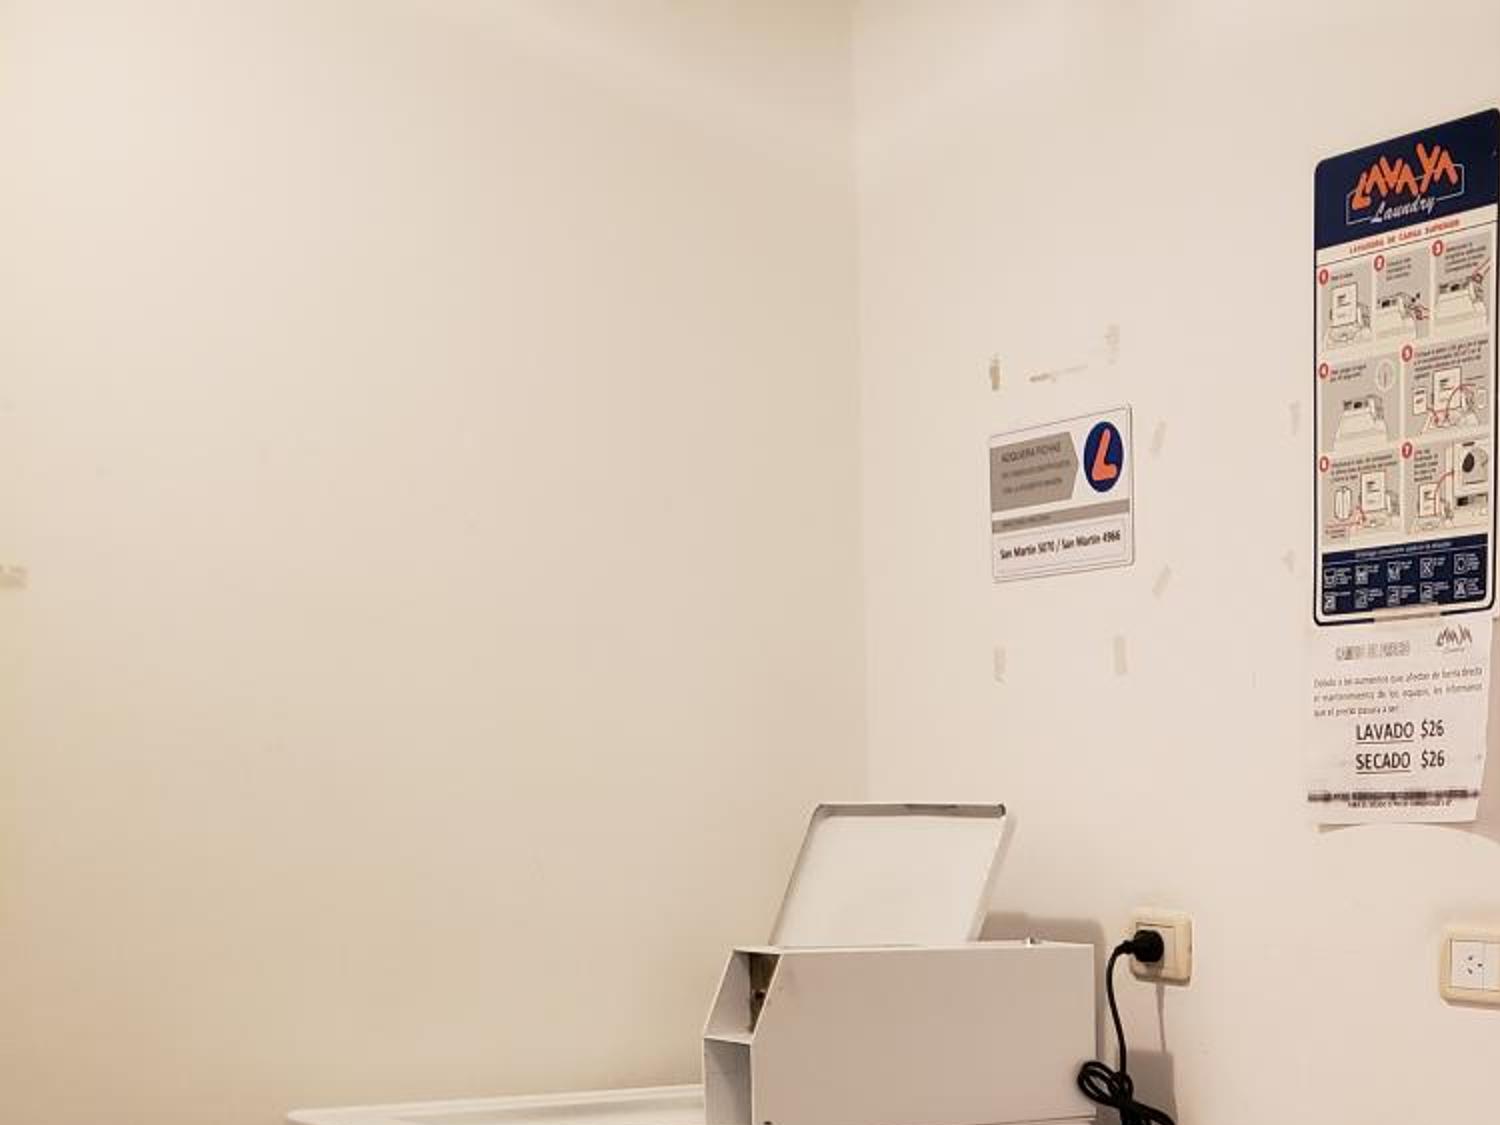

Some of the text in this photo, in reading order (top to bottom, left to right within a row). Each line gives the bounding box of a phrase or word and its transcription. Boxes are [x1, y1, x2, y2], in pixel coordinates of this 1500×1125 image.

[1352, 143, 1459, 210] LAVAYA
[1370, 195, 1437, 224] Laundry
[1000, 548, 1012, 560] San
[1356, 719, 1445, 741] LAVADO $26
[1356, 749, 1445, 770] SECADO $26
